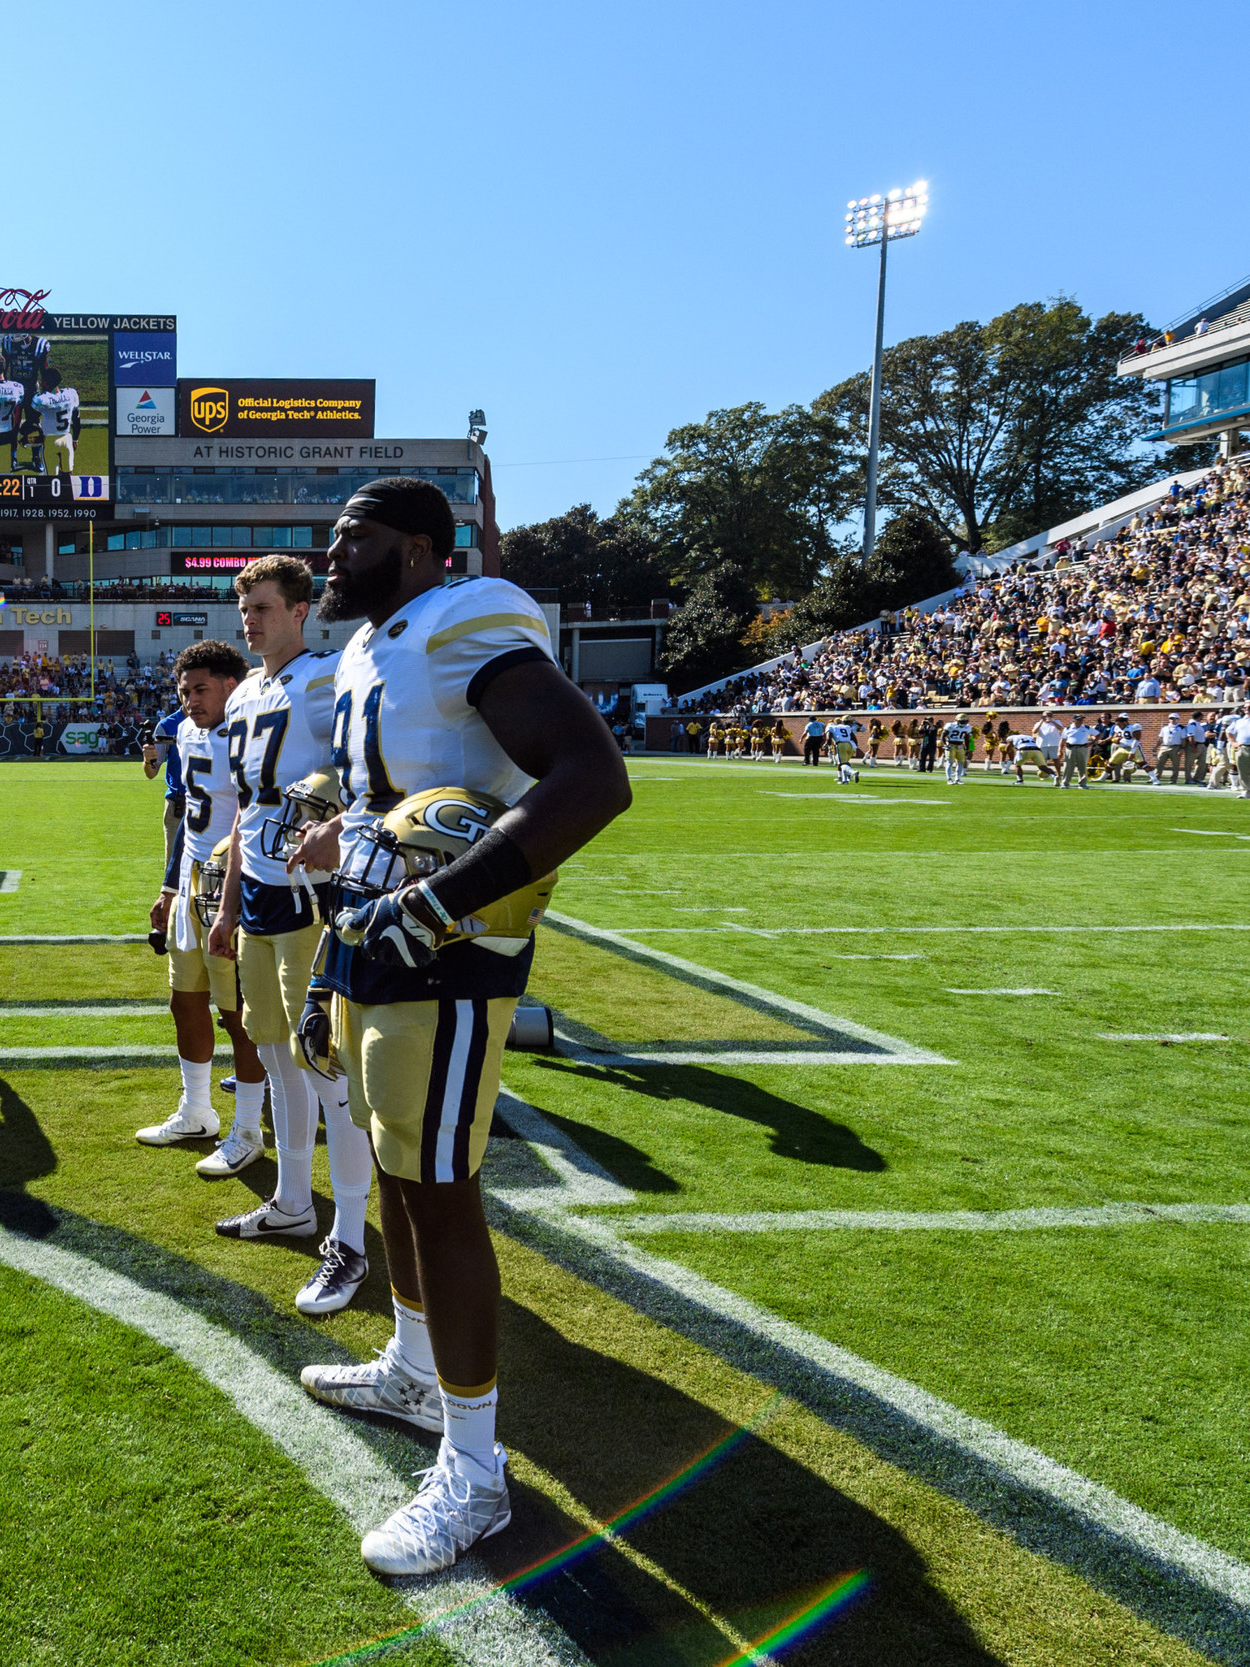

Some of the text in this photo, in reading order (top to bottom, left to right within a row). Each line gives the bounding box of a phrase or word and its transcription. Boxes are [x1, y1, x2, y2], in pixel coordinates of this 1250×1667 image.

[53, 316, 175, 330] YELLOW JACKETS
[118, 350, 172, 362] WELLSTAR
[238, 397, 362, 410] Official Logistics Company
[127, 413, 165, 425] Georgia
[193, 401, 226, 425] ups
[237, 410, 249, 419] of
[249, 410, 286, 421] Georgia
[316, 410, 362, 420] Athletics.
[55, 410, 69, 431] 5
[131, 424, 161, 434] Power
[193, 446, 404, 459] AT HISTORIC GRANT FIELD
[26, 477, 37, 485] QTR
[78, 476, 102, 498] D
[74, 509, 97, 518] 1990
[184, 556, 212, 568] $4.99
[212, 557, 246, 568] COMBO
[10, 606, 73, 626] Tech
[158, 612, 171, 625] 25
[65, 730, 100, 749] sag
[840, 728, 849, 738] 9
[330, 680, 408, 816] 91
[186, 755, 213, 835] 5
[423, 798, 490, 844] G
